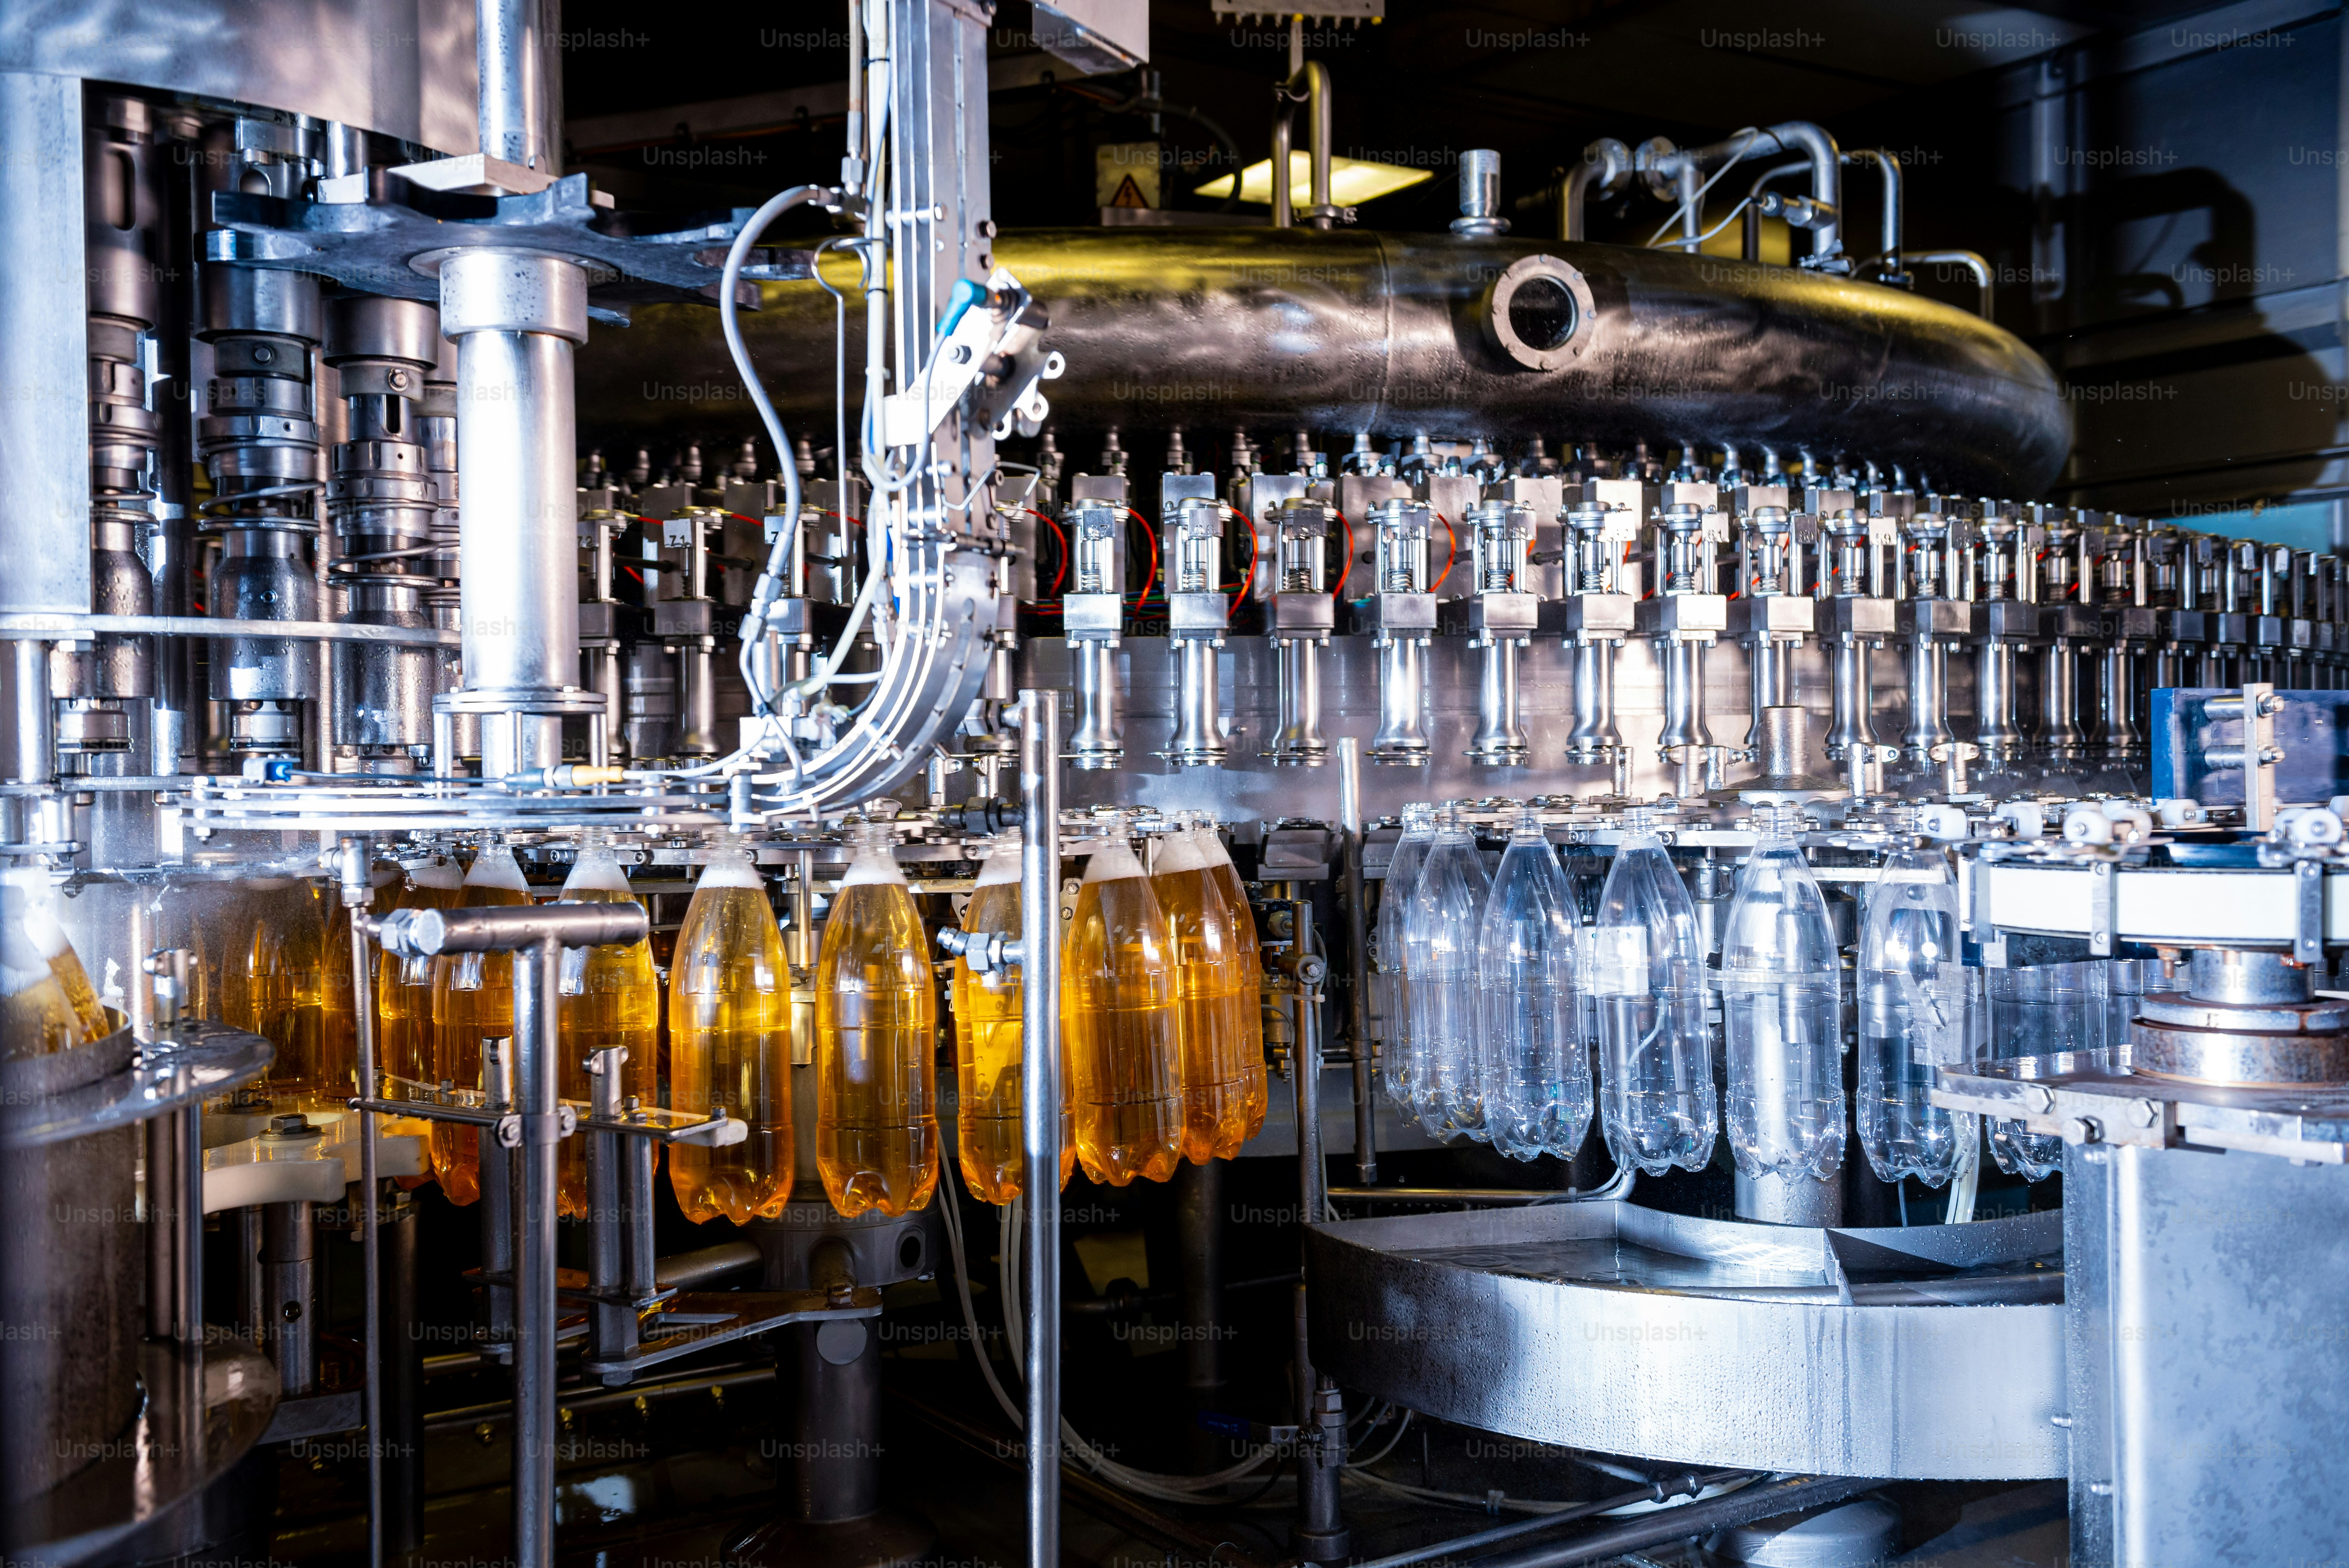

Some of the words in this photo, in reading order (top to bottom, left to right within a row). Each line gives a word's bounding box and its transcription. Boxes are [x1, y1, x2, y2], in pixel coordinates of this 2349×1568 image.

[578, 535, 592, 547] 72
[669, 535, 685, 547] 71
[771, 531, 779, 543] 7
